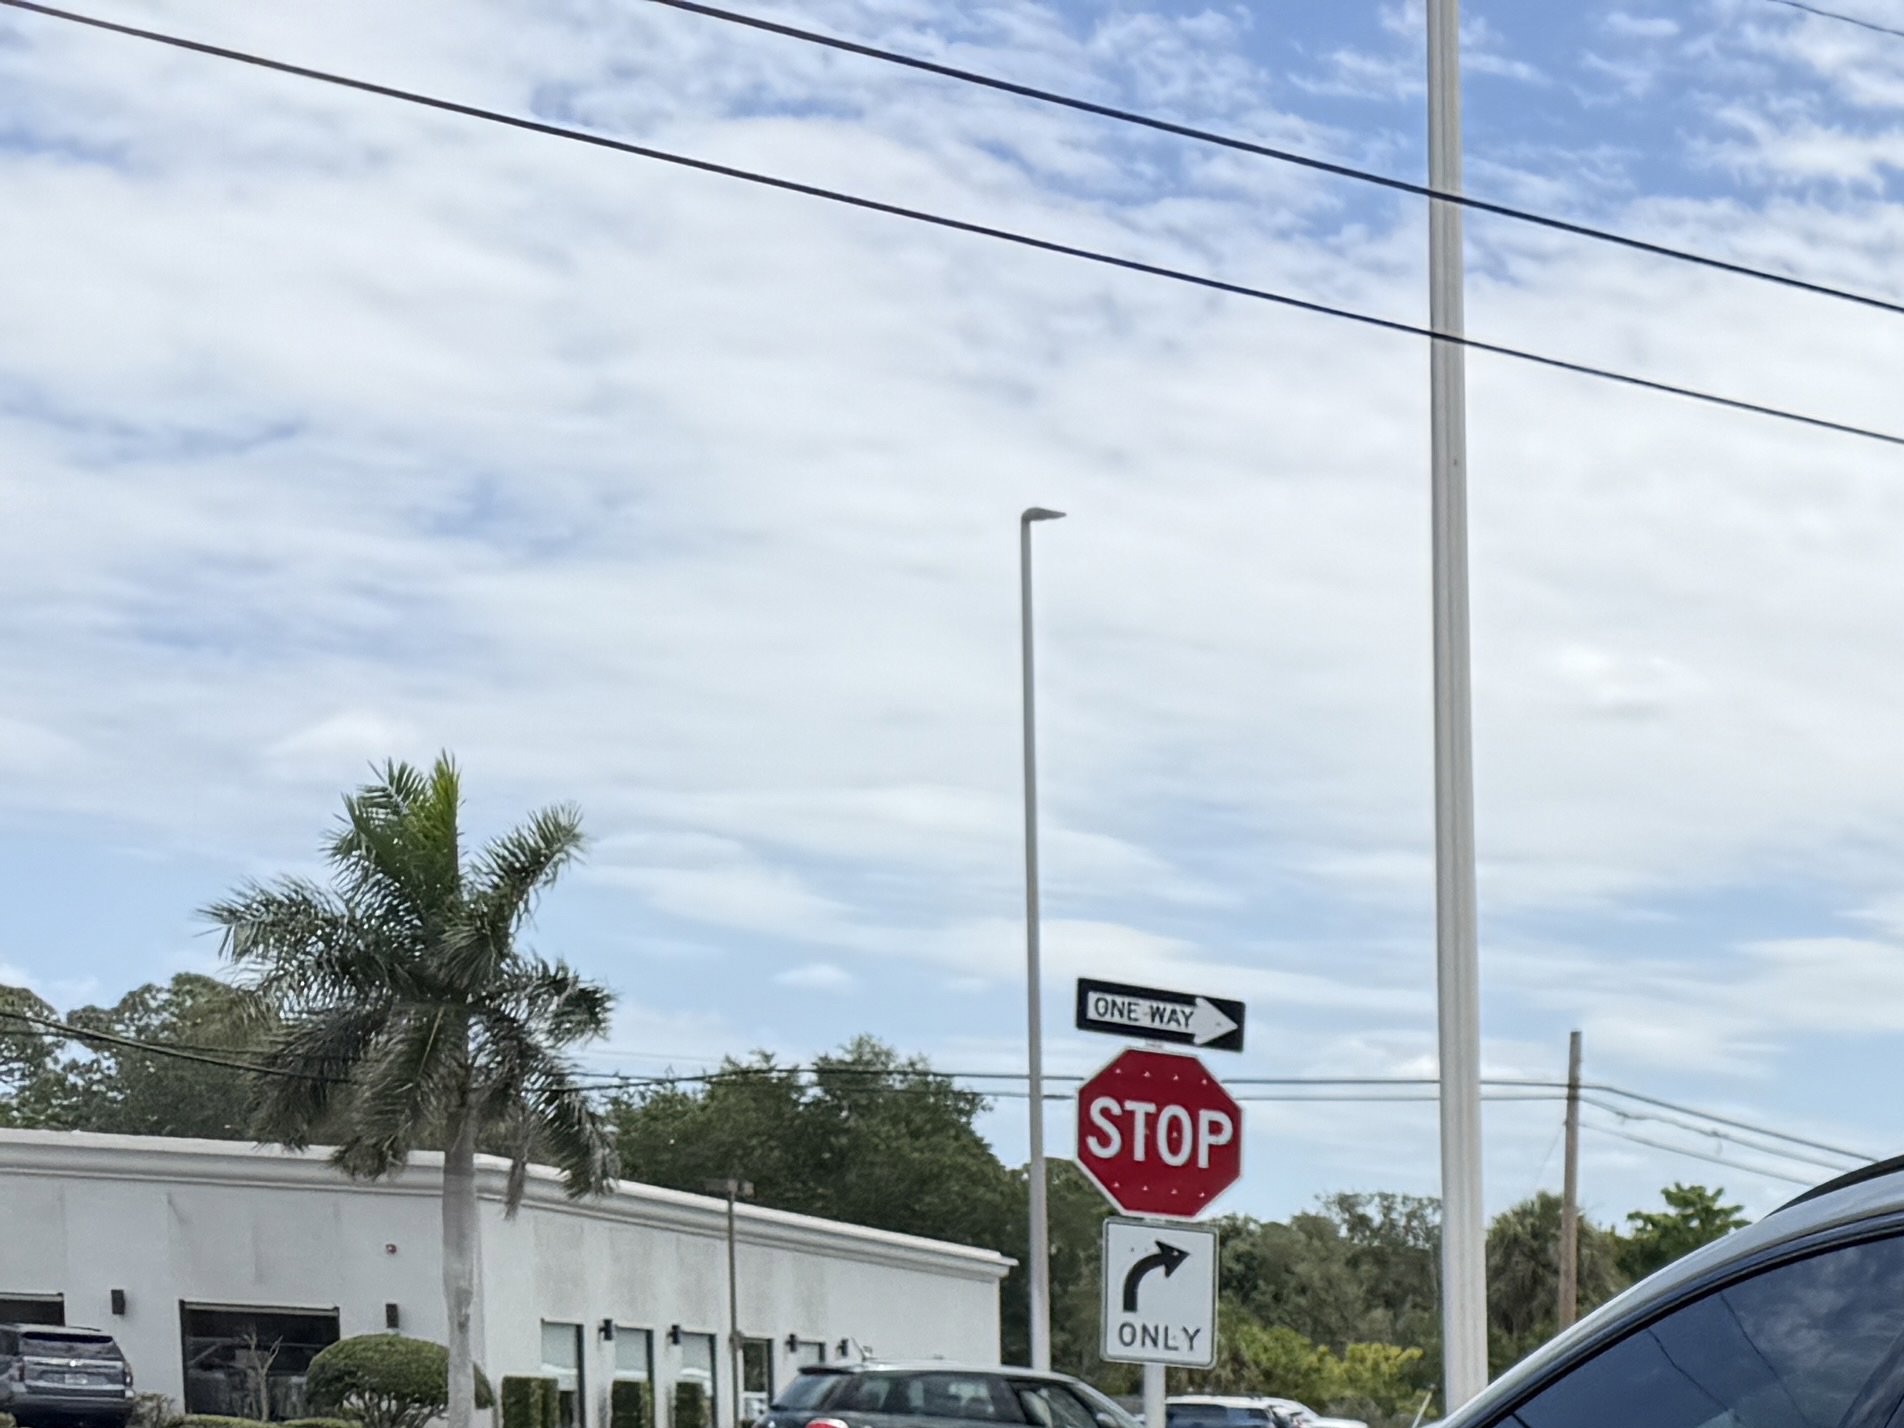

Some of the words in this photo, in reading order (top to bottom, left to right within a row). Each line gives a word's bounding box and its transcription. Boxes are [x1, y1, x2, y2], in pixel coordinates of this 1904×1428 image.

[1093, 996, 1140, 1023] ONE
[1148, 1005, 1196, 1030] WAY
[1085, 1096, 1234, 1169] STOP
[1117, 1321, 1202, 1353] ONLY
